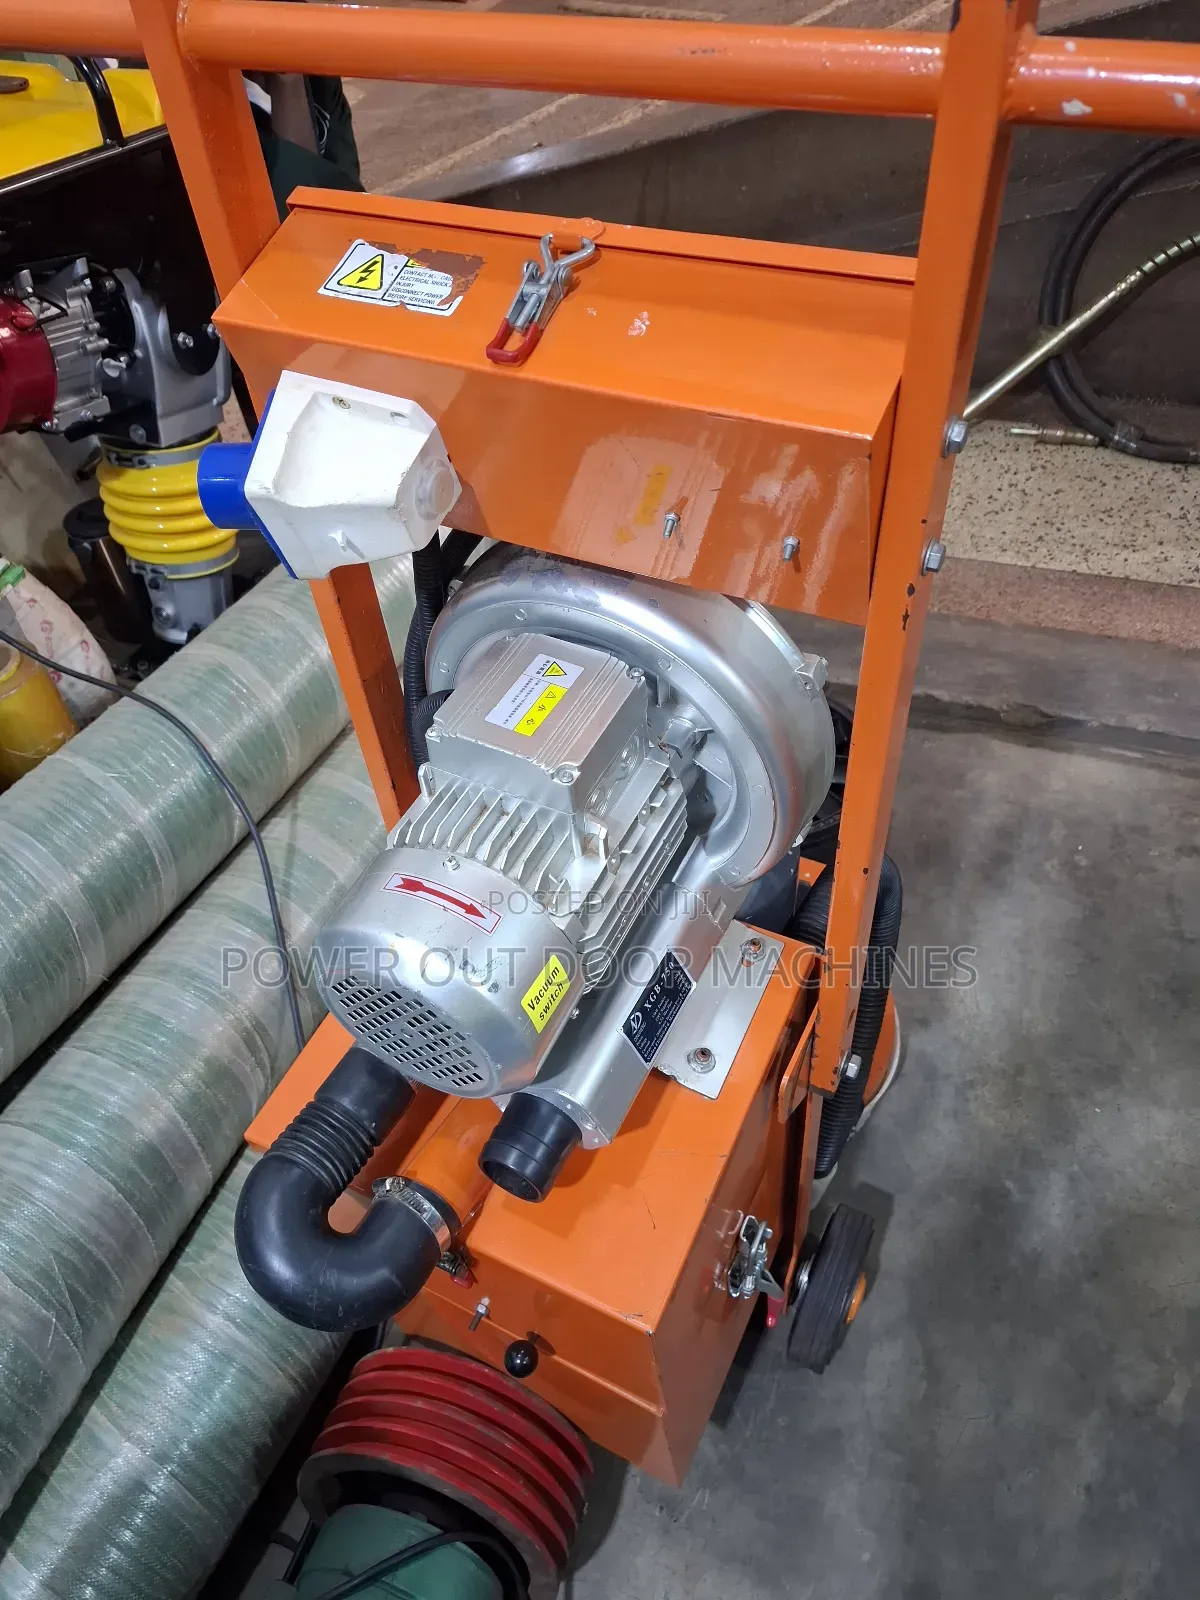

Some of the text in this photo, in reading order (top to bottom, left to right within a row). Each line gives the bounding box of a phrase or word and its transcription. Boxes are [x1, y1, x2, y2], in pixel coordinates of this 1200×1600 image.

[403, 269, 427, 278] CONTACT
[399, 275, 430, 285] ELECTRICAL
[387, 292, 407, 300] BEFORE
[391, 287, 424, 296] DISCONNECT
[527, 966, 560, 1011] Vacuum
[643, 961, 674, 1012] XGB-750
[539, 982, 564, 1021] switch
